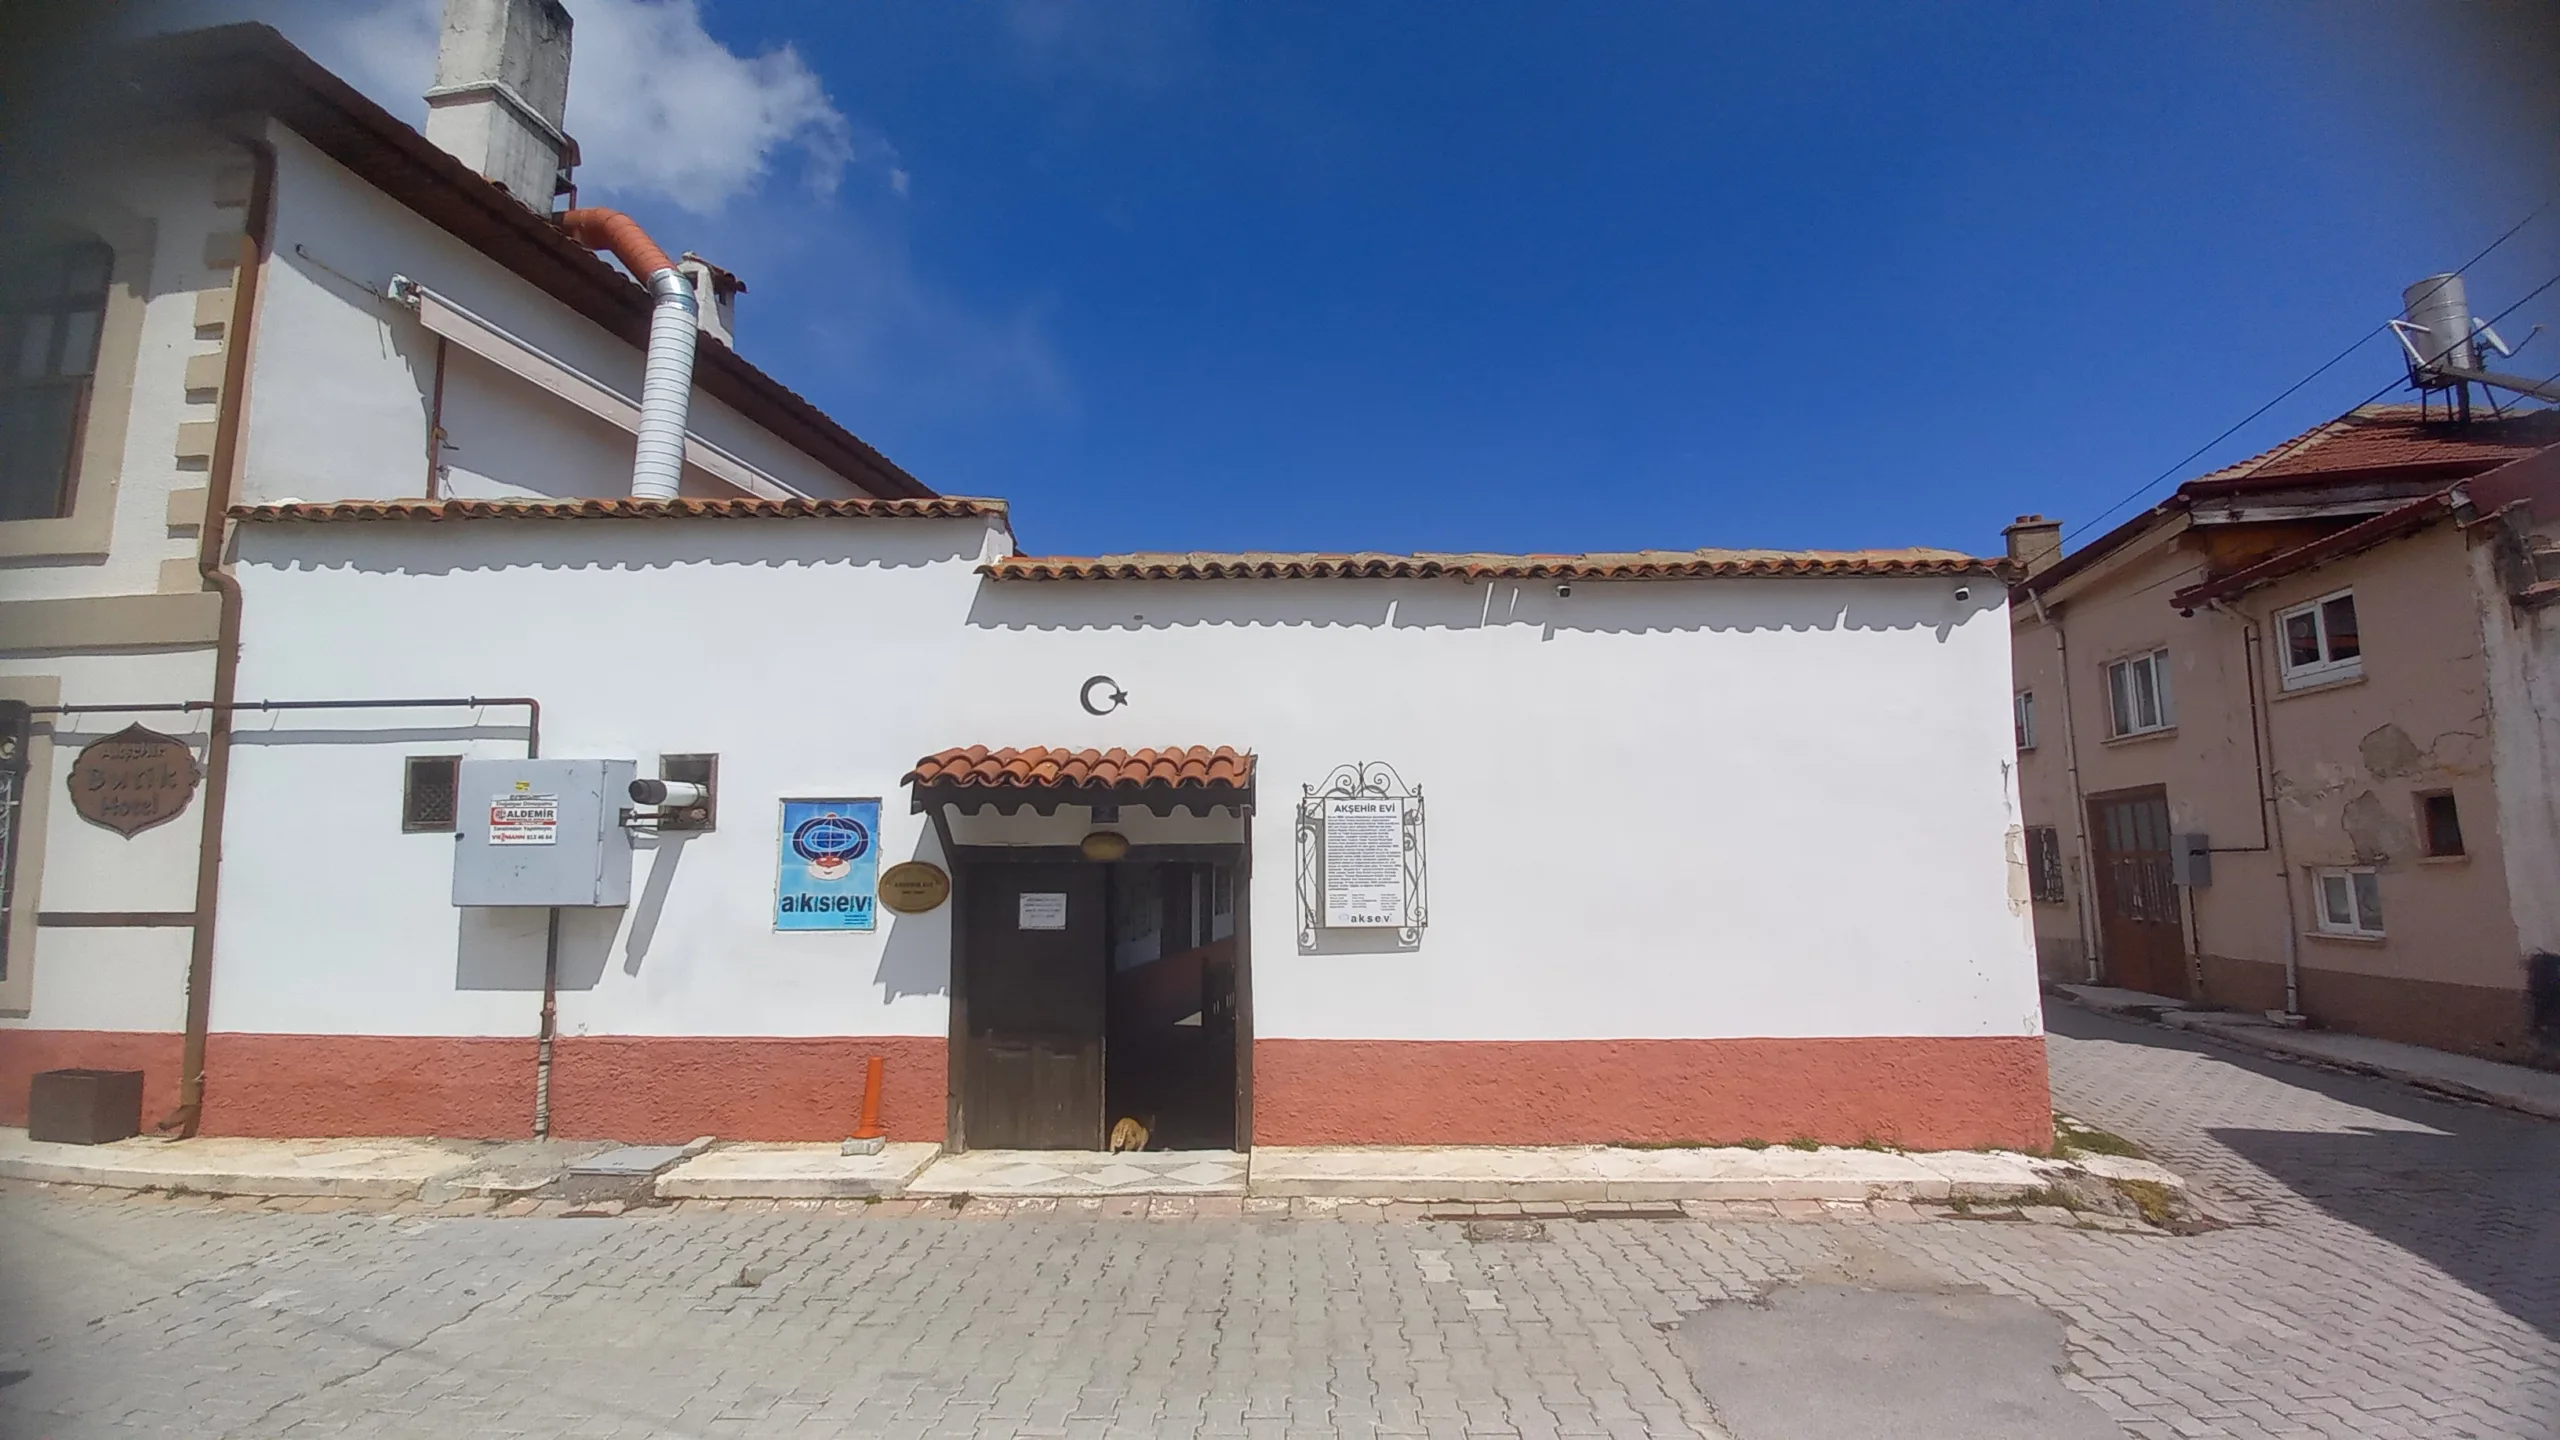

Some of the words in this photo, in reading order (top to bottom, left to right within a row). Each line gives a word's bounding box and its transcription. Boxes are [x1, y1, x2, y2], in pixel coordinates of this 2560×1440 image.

[101, 793, 159, 817] Hotel
[1334, 802, 1377, 814] AKŞEHİR
[1379, 802, 1396, 813] EVİ
[507, 808, 554, 818] ALDEMİR
